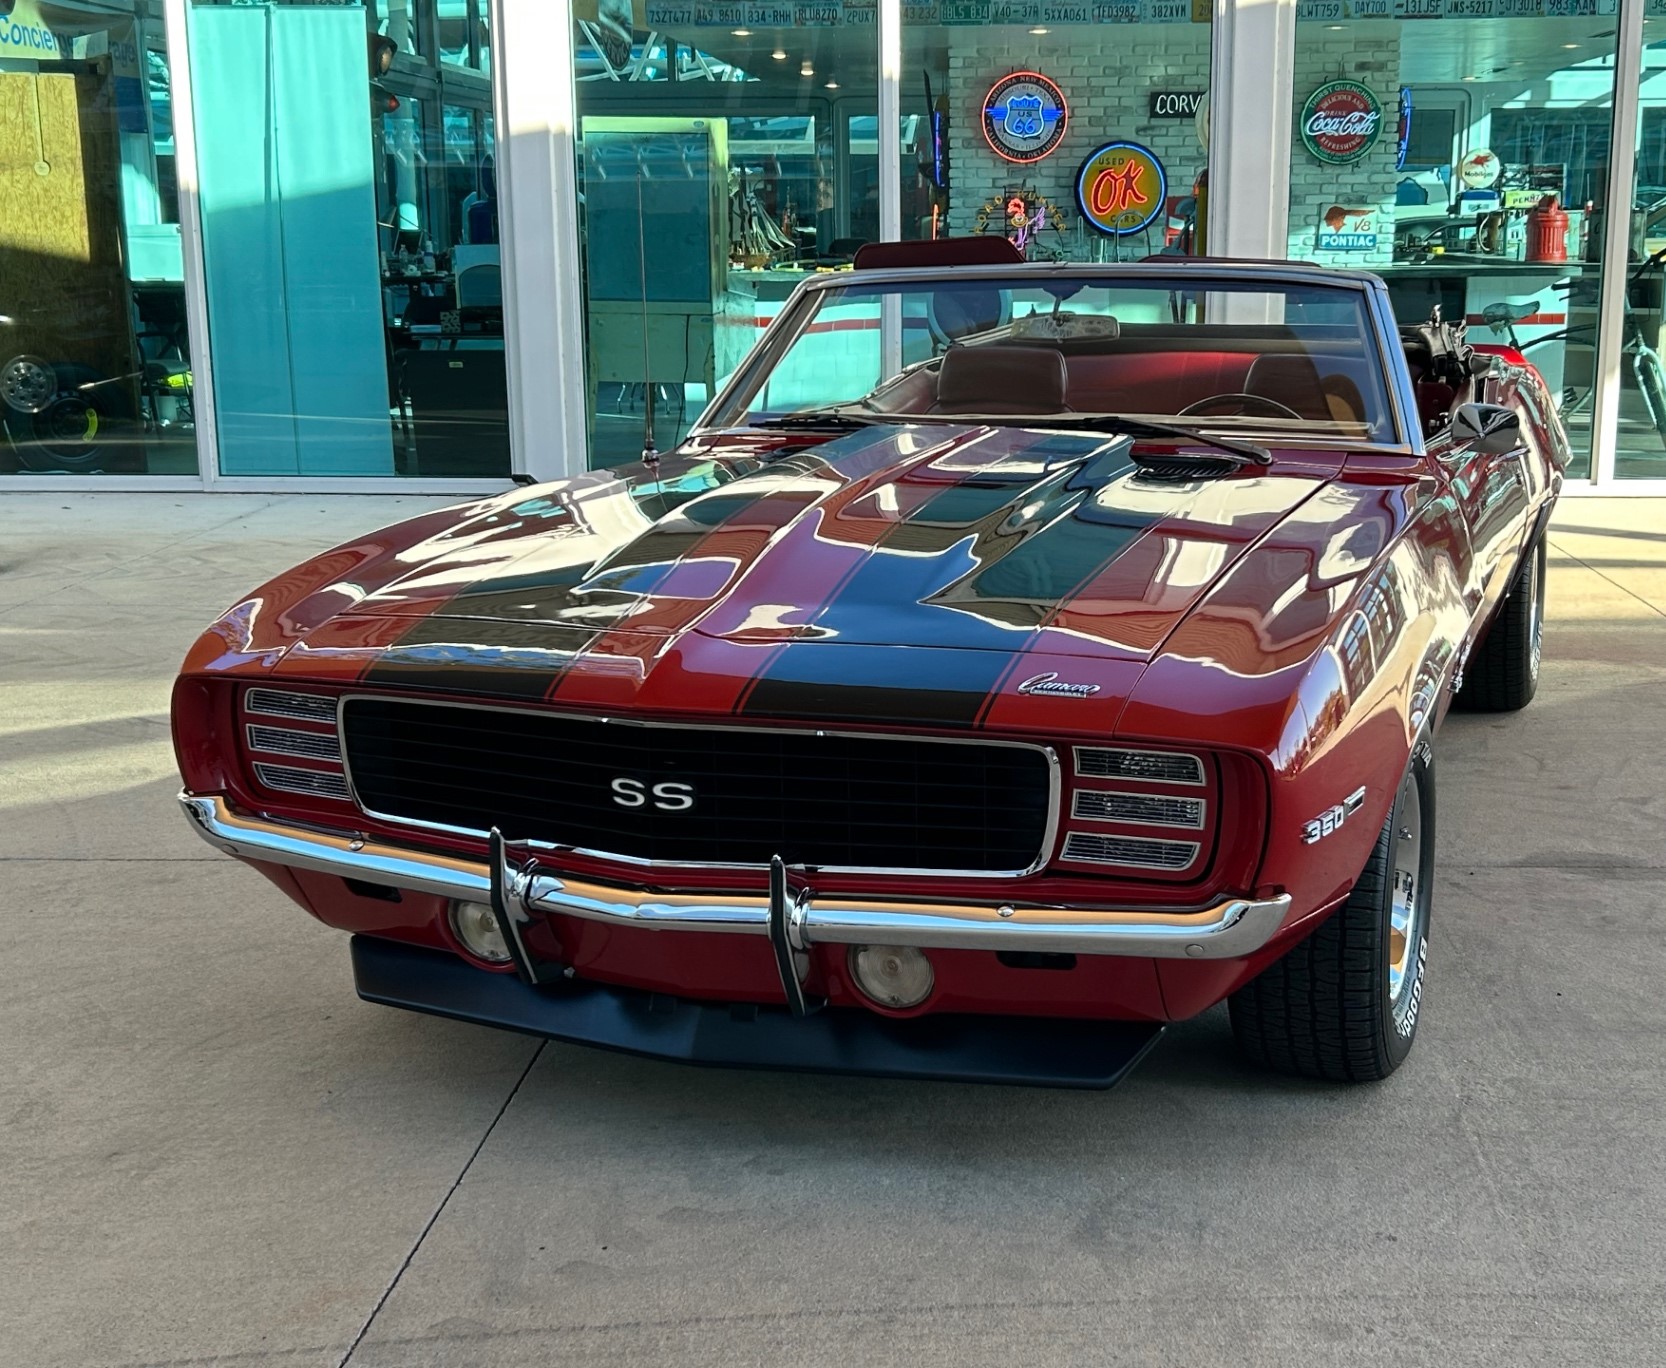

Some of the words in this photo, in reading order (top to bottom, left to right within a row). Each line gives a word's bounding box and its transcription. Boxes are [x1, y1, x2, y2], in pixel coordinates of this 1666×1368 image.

[1154, 94, 1204, 114] CORV
[1309, 87, 1333, 109] THIRST
[1334, 84, 1376, 109] QUENCHING
[1012, 118, 1035, 134] 66
[1304, 110, 1381, 137] Coca-Cola
[1320, 136, 1361, 150] REFRESHING
[1098, 157, 1125, 165] USED
[1091, 159, 1148, 215] OK
[1354, 217, 1371, 233] V8
[1321, 235, 1374, 247] PONTIAC
[1018, 672, 1101, 695] Camaro
[611, 778, 694, 810] SS
[1302, 805, 1344, 845] 350
